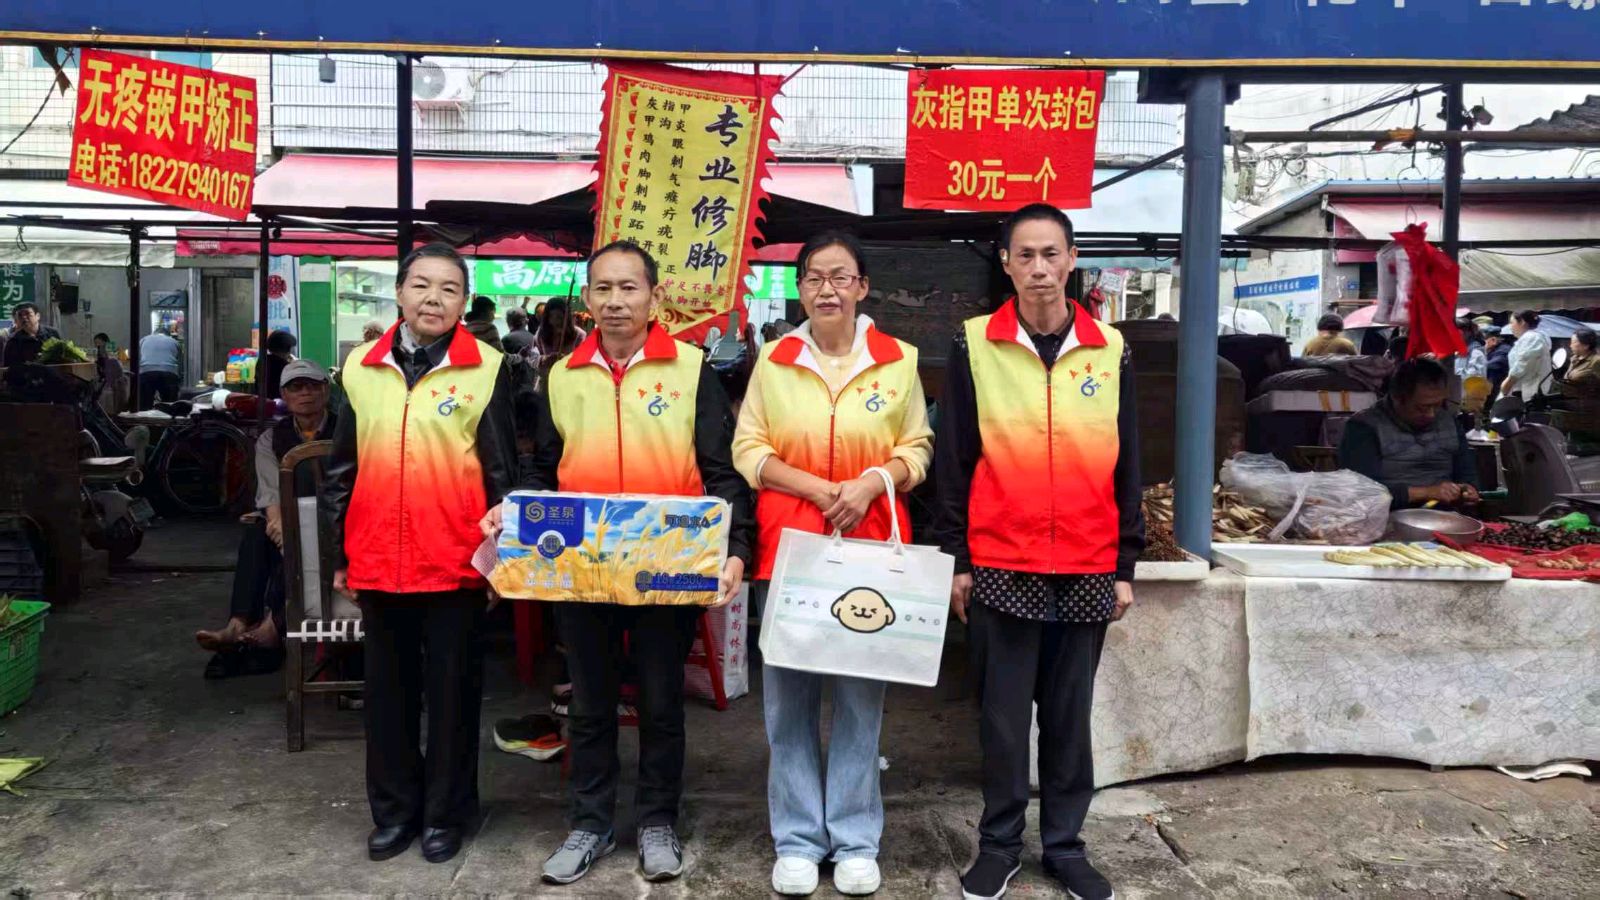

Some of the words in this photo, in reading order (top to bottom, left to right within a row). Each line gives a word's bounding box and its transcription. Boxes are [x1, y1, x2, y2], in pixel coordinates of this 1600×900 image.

[80, 59, 255, 153] 无疼嵌甲矫正
[644, 115, 686, 133] 甲沟炎
[646, 96, 691, 114] 灰指甲
[912, 85, 1096, 131] 灰指甲单次封包
[75, 138, 251, 210] 电话:18227940167
[685, 104, 744, 281] 专业修脚
[947, 157, 1057, 201] 30元一个
[548, 505, 576, 519] 圣泉
